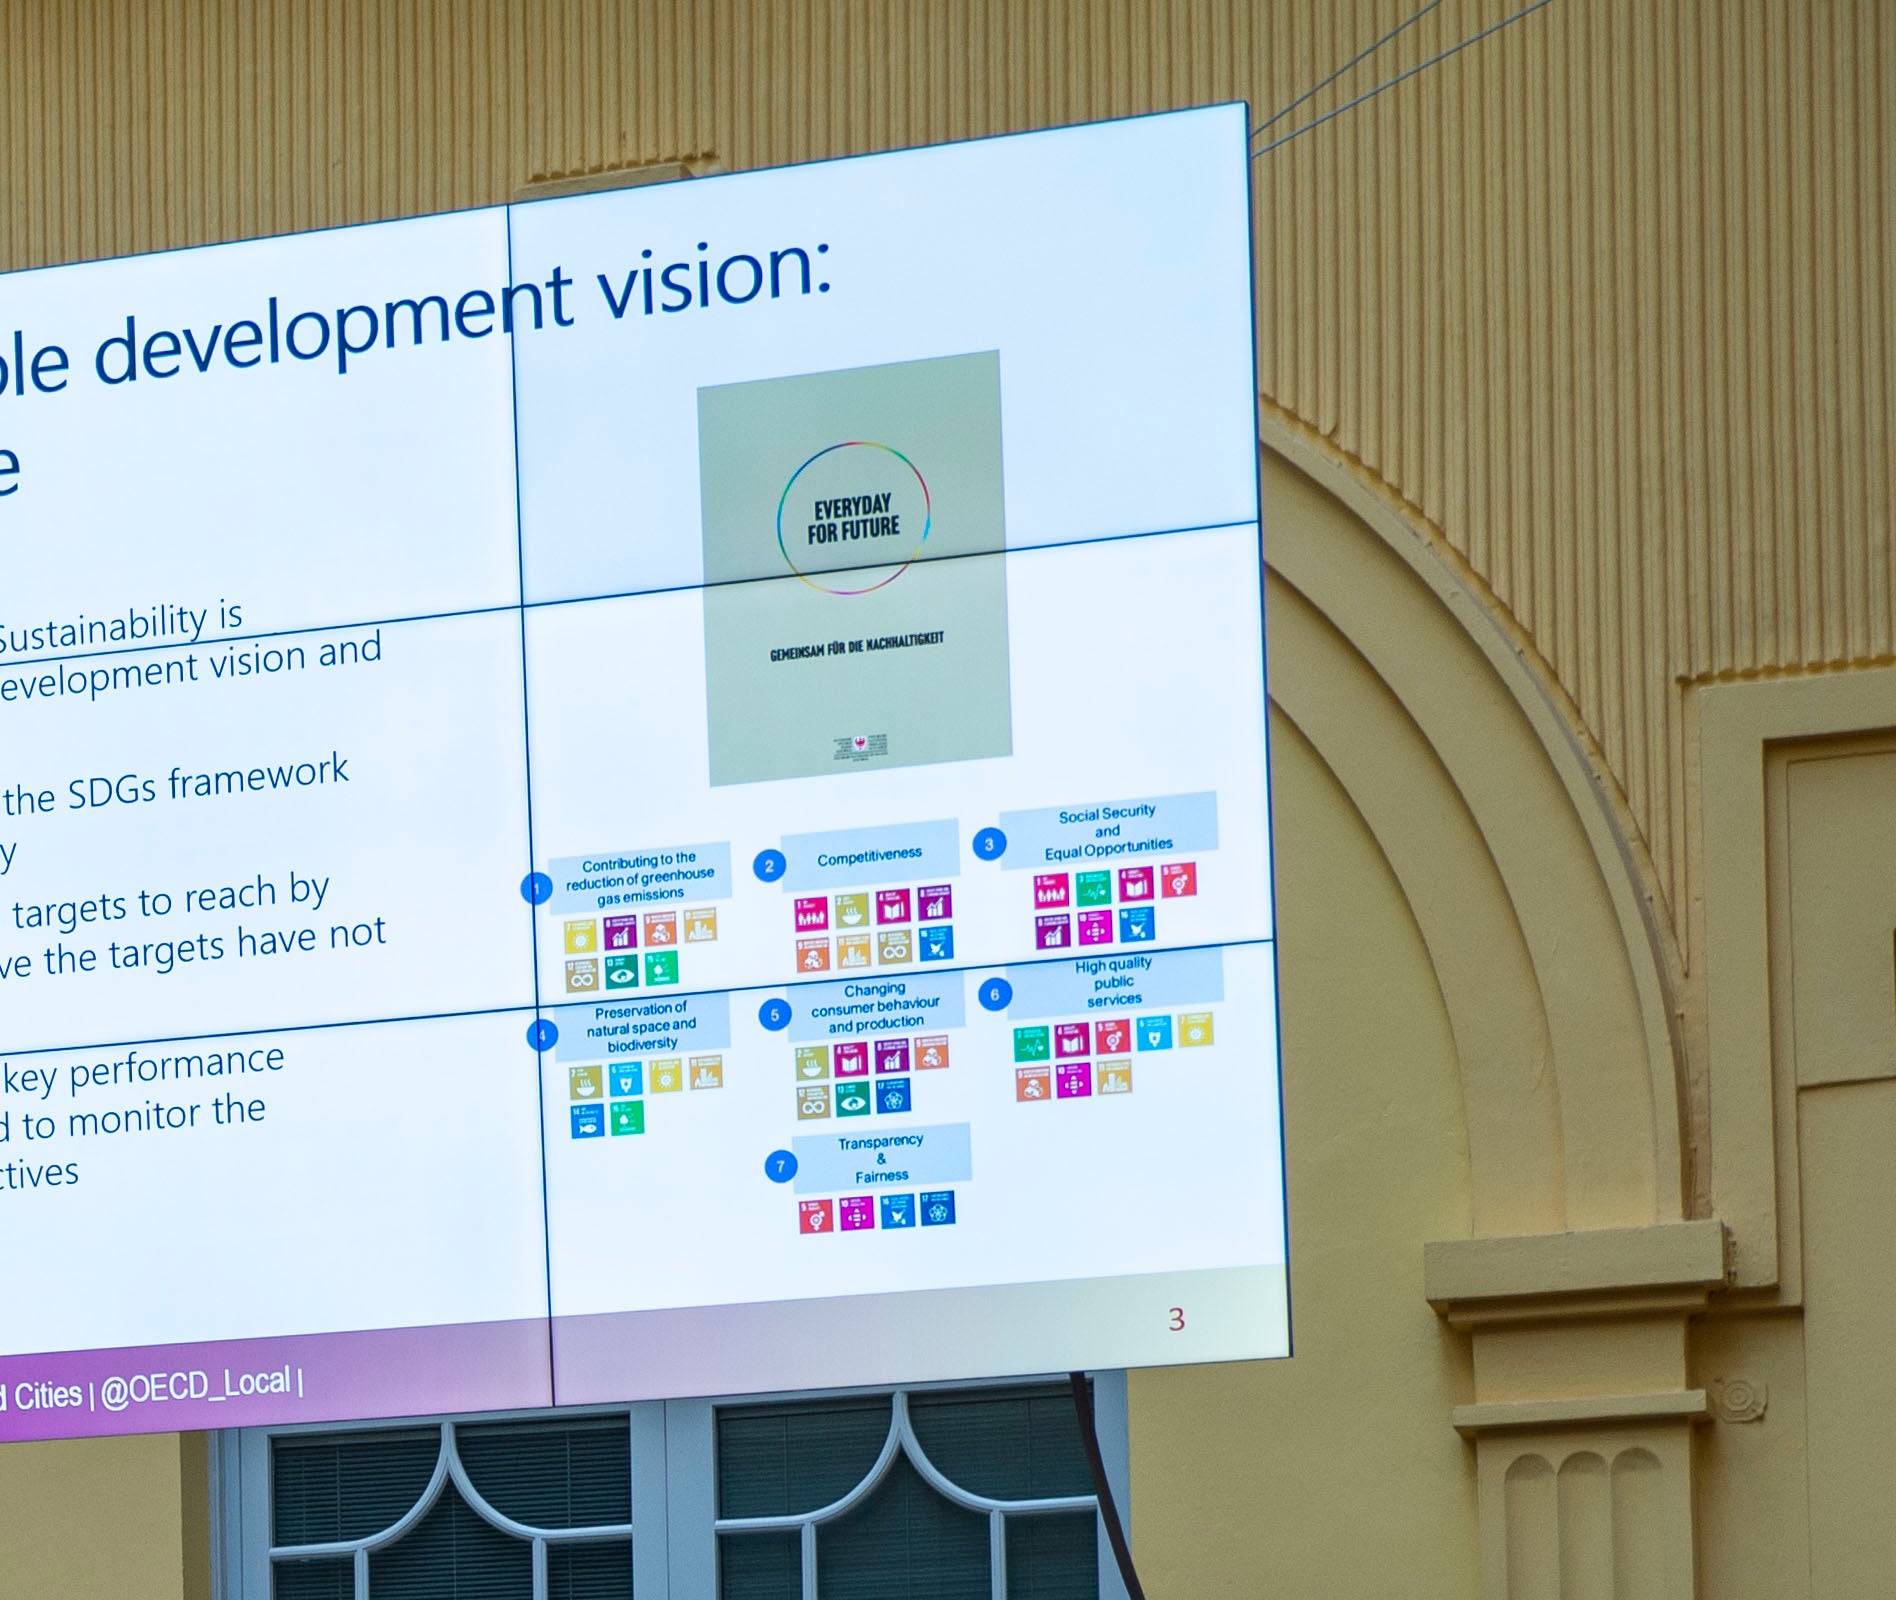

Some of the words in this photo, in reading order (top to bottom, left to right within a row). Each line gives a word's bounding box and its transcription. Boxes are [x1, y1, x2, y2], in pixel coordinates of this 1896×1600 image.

[95, 266, 574, 385] development
[596, 241, 830, 319] vision:
[815, 492, 892, 521] EVERYDAY
[808, 522, 838, 545] FOR
[841, 514, 900, 541] FUTURE
[220, 598, 242, 629] is
[209, 643, 305, 678] vision
[319, 628, 381, 667] and
[770, 644, 825, 662] GEMEINSAM
[827, 640, 846, 656] FÜR
[848, 640, 864, 654] DIE
[866, 630, 944, 651] NACHHALTIGKEIT
[2, 784, 55, 816] the
[69, 774, 156, 809] SDGs
[167, 750, 349, 799] framework
[1059, 808, 1099, 824] Social
[1102, 804, 1156, 820] Security
[1095, 824, 1121, 838] and
[984, 838, 994, 851] 3
[1045, 845, 1082, 862] Equal
[1084, 837, 1174, 858] Opportunities
[582, 855, 659, 873] Contributing
[660, 853, 673, 866] to
[676, 852, 696, 864] the
[765, 859, 774, 873] 2
[818, 847, 922, 867] Competitiveness
[566, 876, 625, 892] reduction
[626, 873, 639, 886] of
[640, 868, 715, 887] greenhouse
[12, 894, 127, 935] targets
[138, 890, 172, 917] to
[186, 874, 276, 912] reach
[290, 871, 330, 910] by
[597, 894, 621, 908] gas
[623, 888, 685, 904] emissions
[43, 942, 97, 975] the
[108, 934, 224, 975] targets
[238, 925, 316, 957] have
[331, 916, 387, 949] not
[1075, 959, 1107, 976] High
[1108, 956, 1153, 973] quality
[844, 981, 906, 998] Changing
[1094, 975, 1135, 993] public
[989, 988, 1000, 1002] 6
[1087, 993, 1143, 1008] services
[595, 998, 673, 1021] Preservation
[674, 998, 688, 1014] of
[770, 1009, 780, 1022] 5
[811, 1003, 875, 1018] consumer
[877, 997, 941, 1013] behaviour
[587, 1022, 630, 1038] natural
[631, 1021, 671, 1035] space
[672, 1017, 696, 1031] and
[828, 1019, 853, 1034] and
[856, 1015, 924, 1033] production
[607, 1036, 678, 1053] biodiversity
[4, 1062, 58, 1100] key
[70, 1049, 284, 1098] performance
[22, 1113, 55, 1140] to
[69, 1100, 201, 1136] monitor
[211, 1092, 266, 1125] the
[838, 1134, 924, 1151] Transparency
[776, 1160, 785, 1173] 7
[876, 1152, 886, 1165] &
[855, 1170, 909, 1184] Fairness
[1168, 1307, 1185, 1332] 3
[15, 1381, 83, 1410] Cities
[101, 1364, 290, 1411] @OECD_Local
